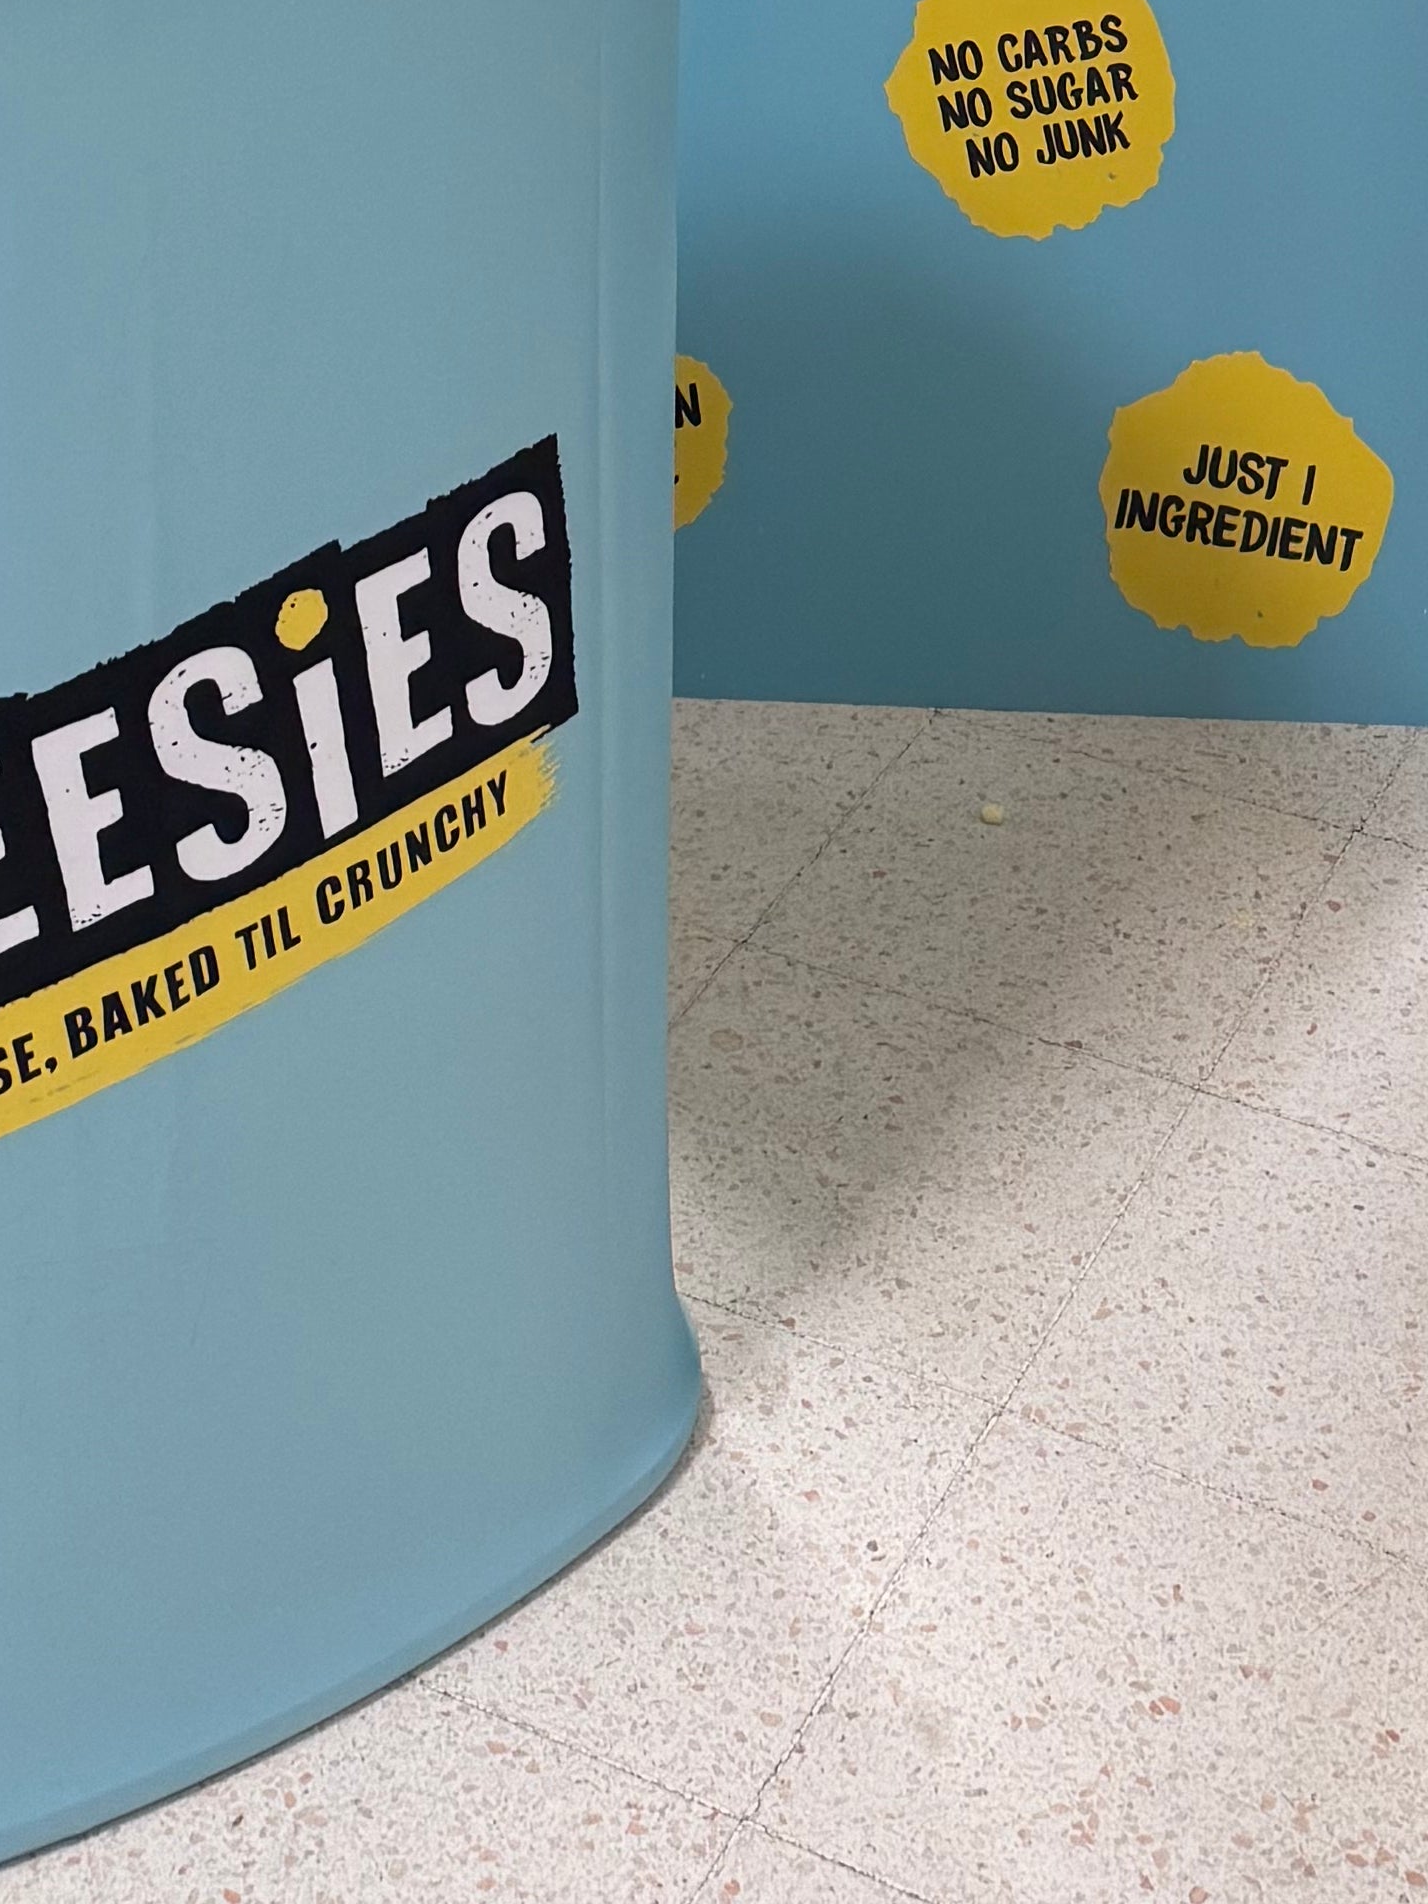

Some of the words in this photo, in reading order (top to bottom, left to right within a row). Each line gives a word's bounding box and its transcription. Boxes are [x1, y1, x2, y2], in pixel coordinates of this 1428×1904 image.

[927, 39, 984, 86] NO
[997, 14, 1129, 73] CARBS
[937, 87, 993, 133] NO
[1006, 63, 1139, 120] SUGAR
[965, 132, 1019, 178] NO
[1036, 110, 1131, 165] JUNK
[1181, 444, 1289, 500] JUST
[1115, 488, 1364, 572] INGREDIENT
[62, 944, 220, 1060] BAKED
[233, 910, 302, 975] TIL
[315, 770, 515, 928] CRUNCHY
